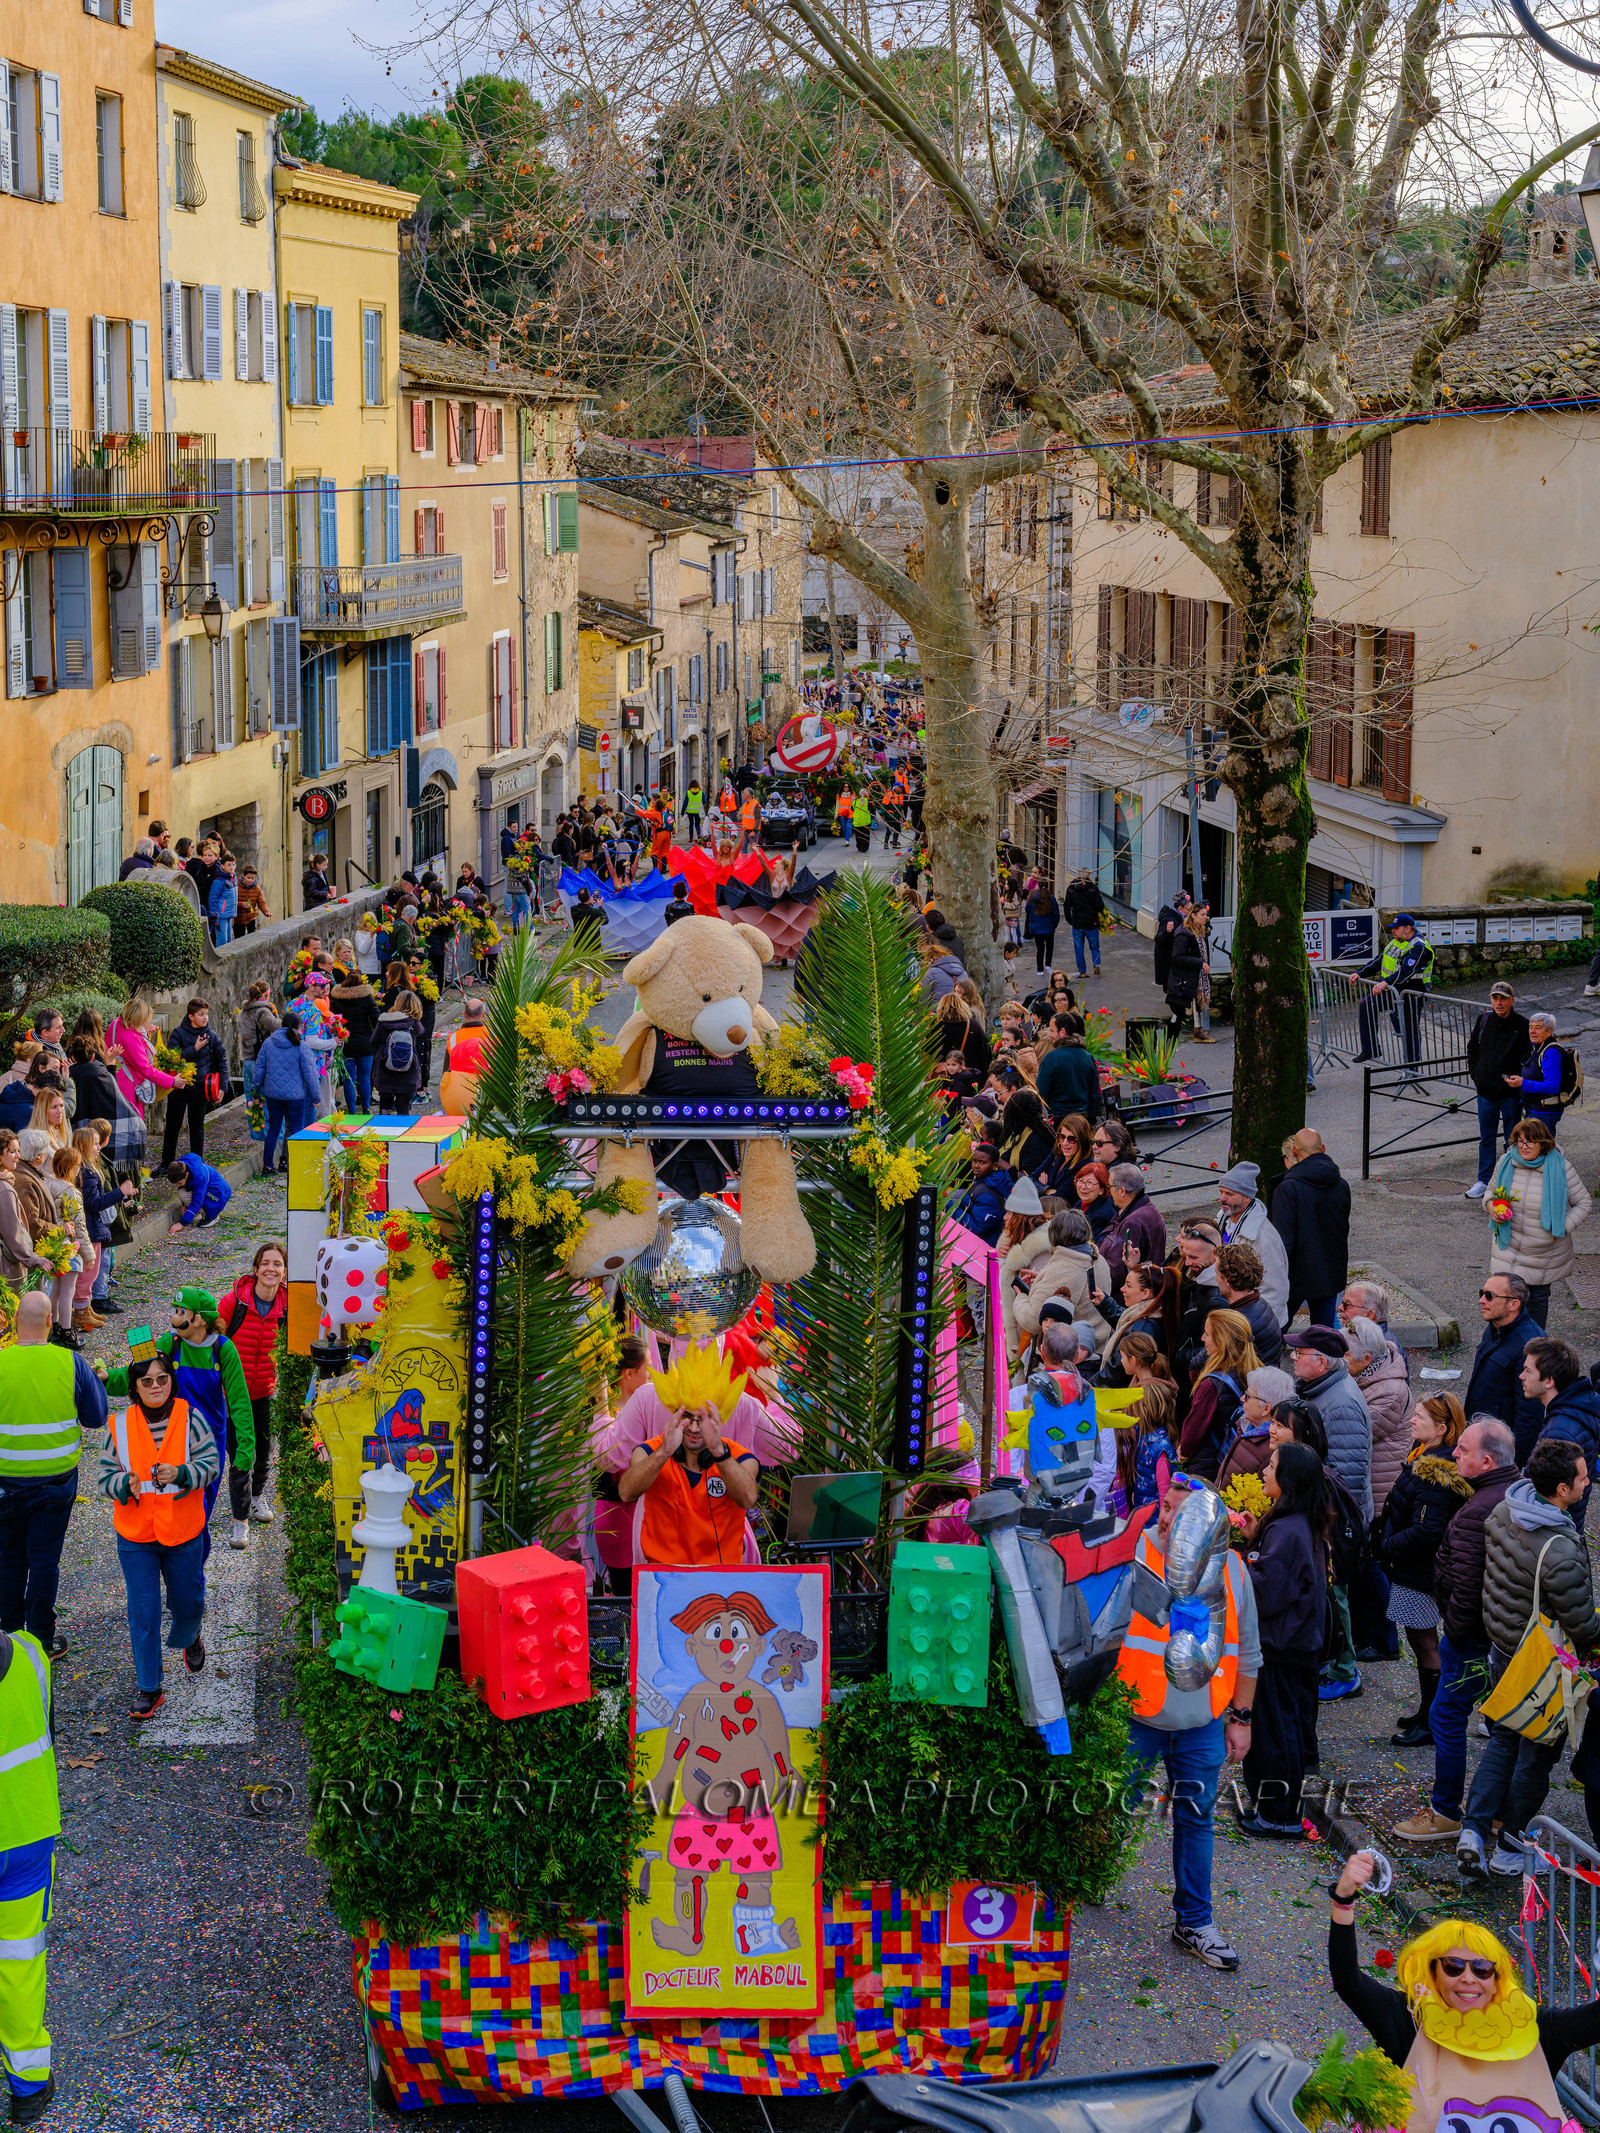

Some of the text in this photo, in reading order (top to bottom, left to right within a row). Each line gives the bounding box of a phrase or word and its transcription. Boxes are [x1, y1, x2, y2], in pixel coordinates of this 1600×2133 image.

[311, 797, 324, 815] B
[667, 1040, 689, 1048] BONS
[665, 1049, 700, 1058] RESTENT
[674, 1058, 734, 1067] BONNES MAINS
[970, 1887, 1005, 1936] 3
[644, 1963, 809, 1997] DOCTEUR MABOUL
